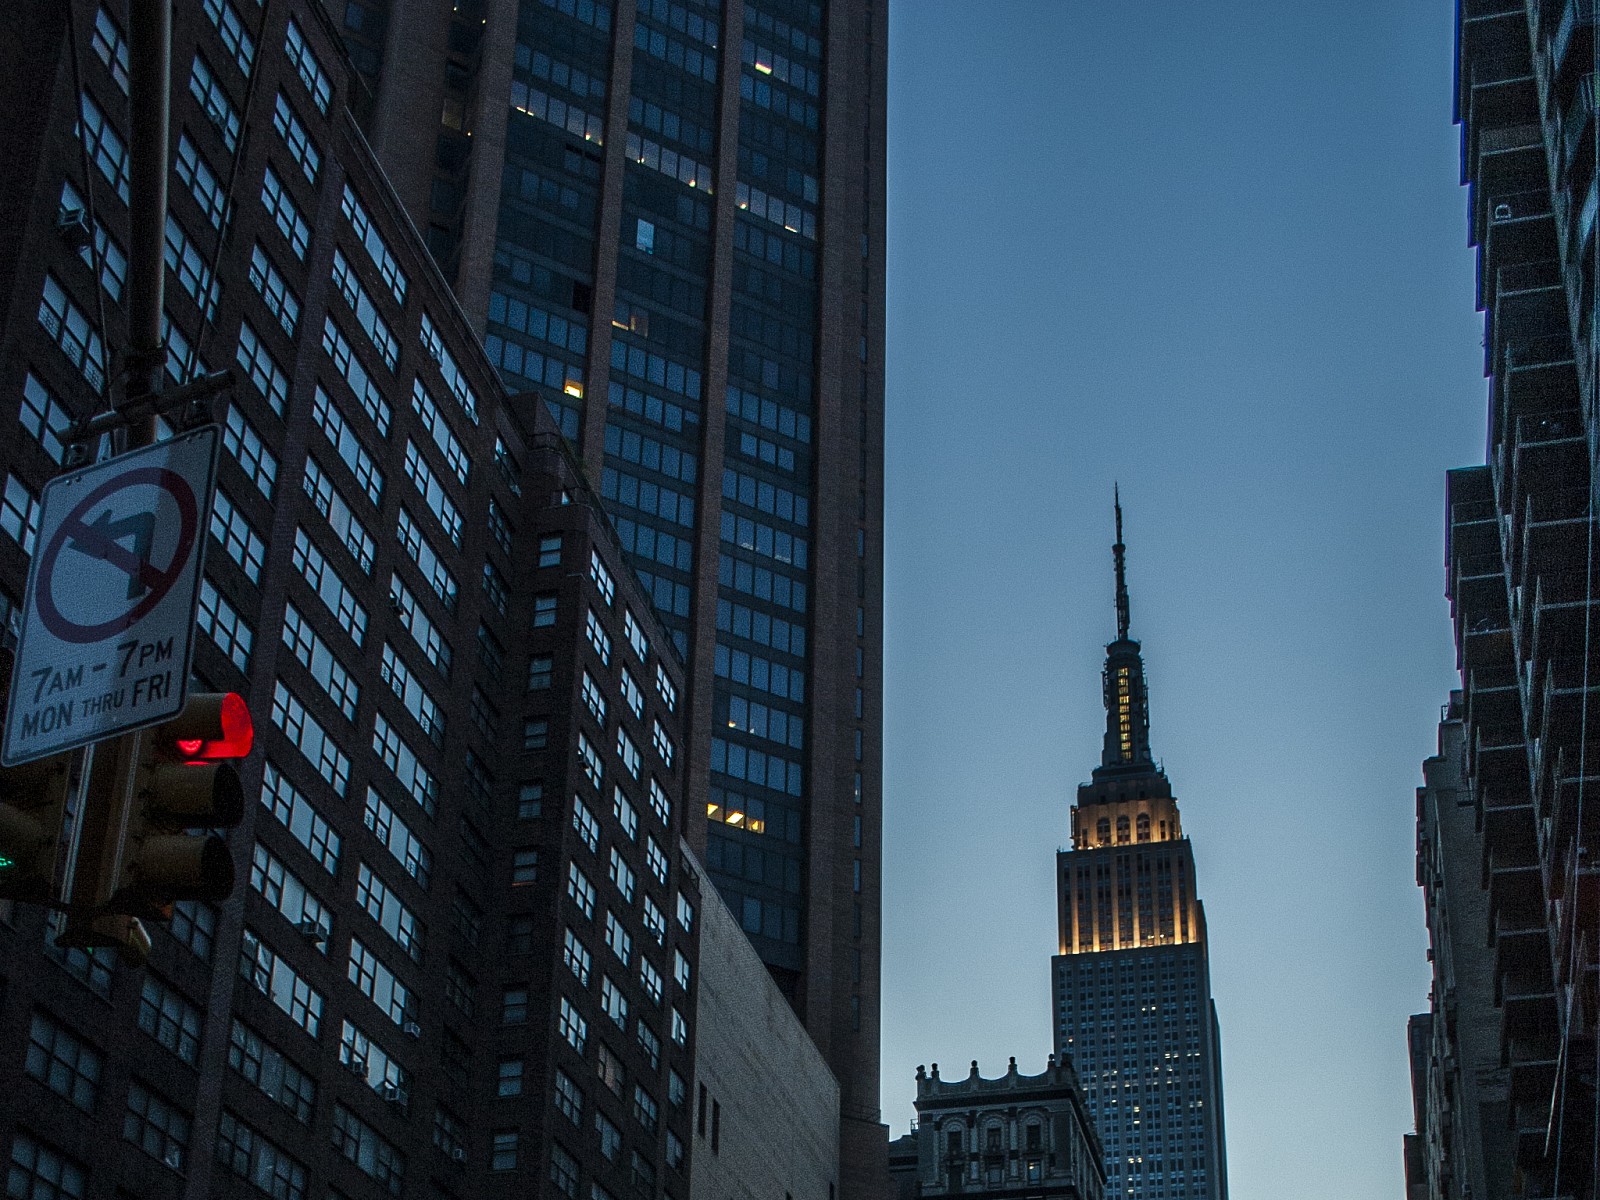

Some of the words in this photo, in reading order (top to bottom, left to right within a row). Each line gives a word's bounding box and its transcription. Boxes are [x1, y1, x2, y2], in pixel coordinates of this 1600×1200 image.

[31, 664, 84, 704] 7AM
[117, 636, 174, 677] 7PM
[20, 701, 74, 741] MON
[82, 688, 125, 718] THRU
[132, 670, 171, 707] FRI
